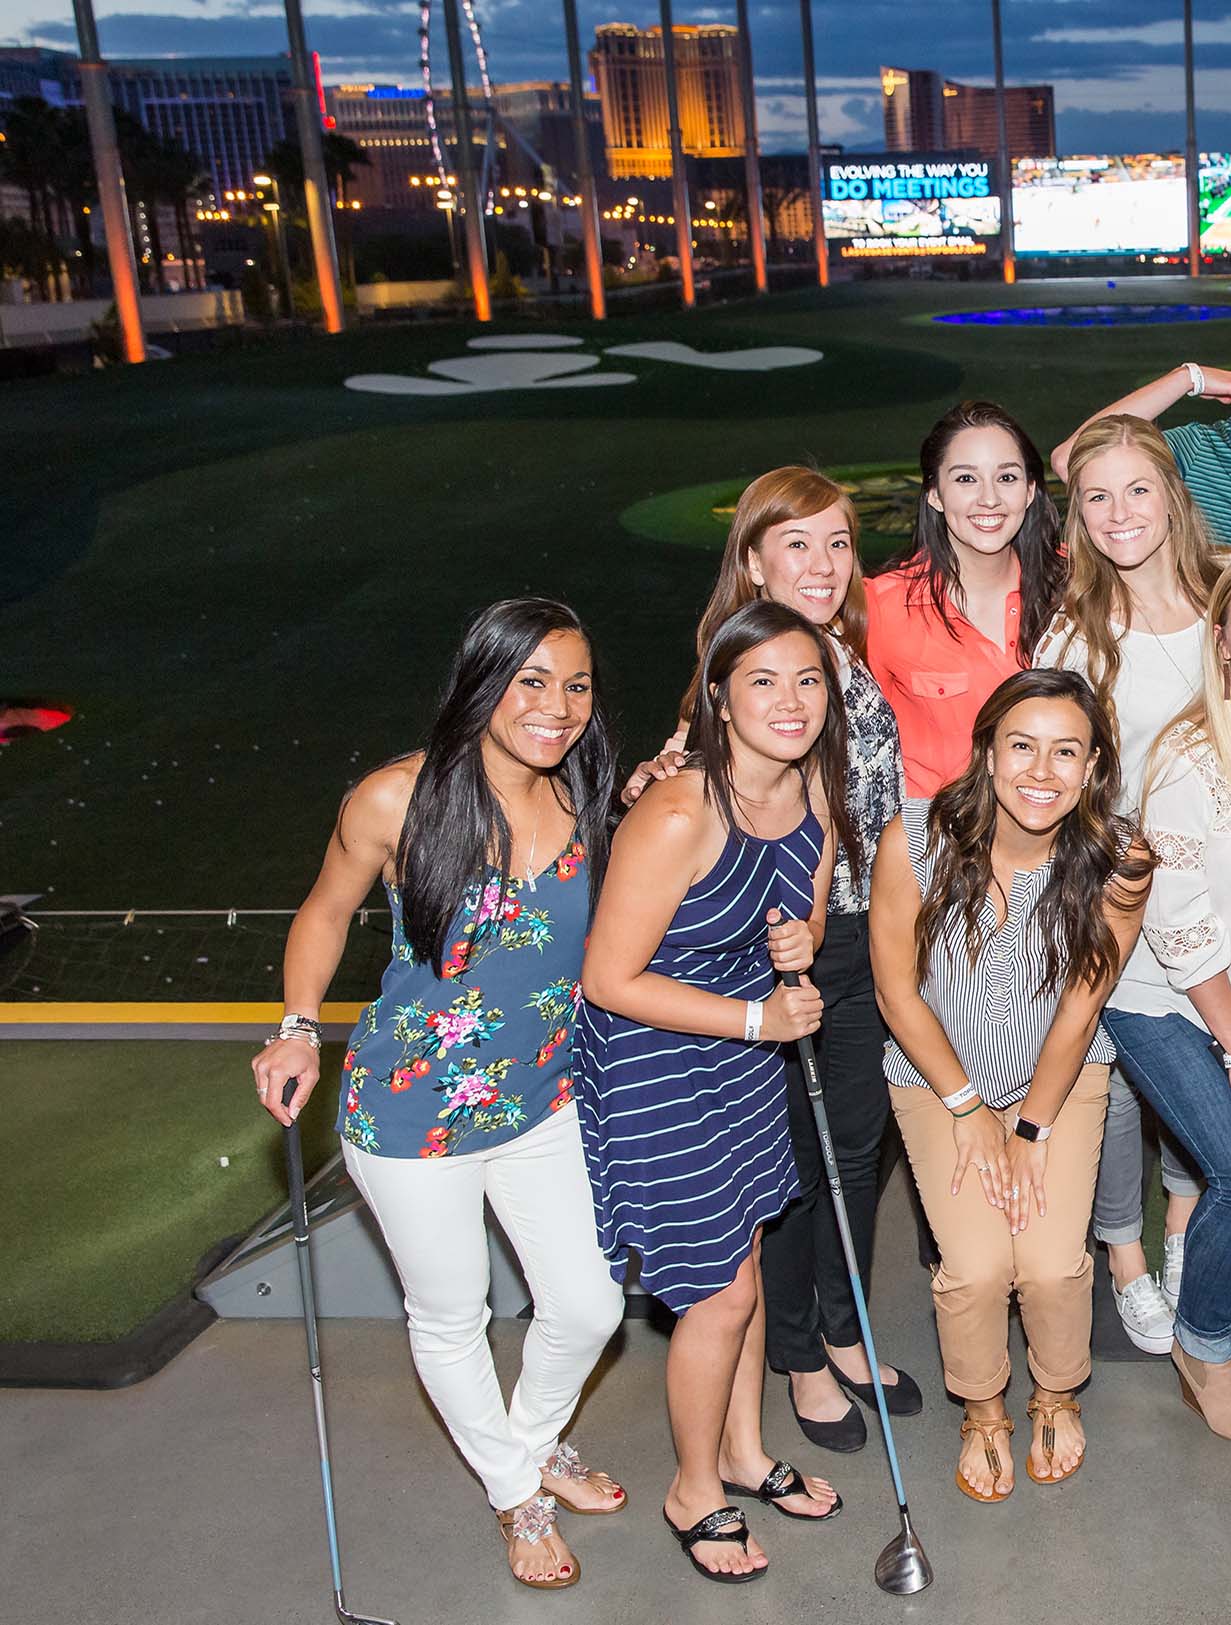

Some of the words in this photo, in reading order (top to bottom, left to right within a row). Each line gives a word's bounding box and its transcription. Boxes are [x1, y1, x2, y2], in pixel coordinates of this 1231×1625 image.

[830, 164, 896, 180] EVOLVING
[897, 163, 925, 179] THE
[926, 163, 957, 178] WAY
[958, 163, 989, 177] YOU
[831, 179, 868, 200] DO
[872, 177, 990, 199] MEETINGS
[822, 1129, 833, 1166] TOPGOLF
